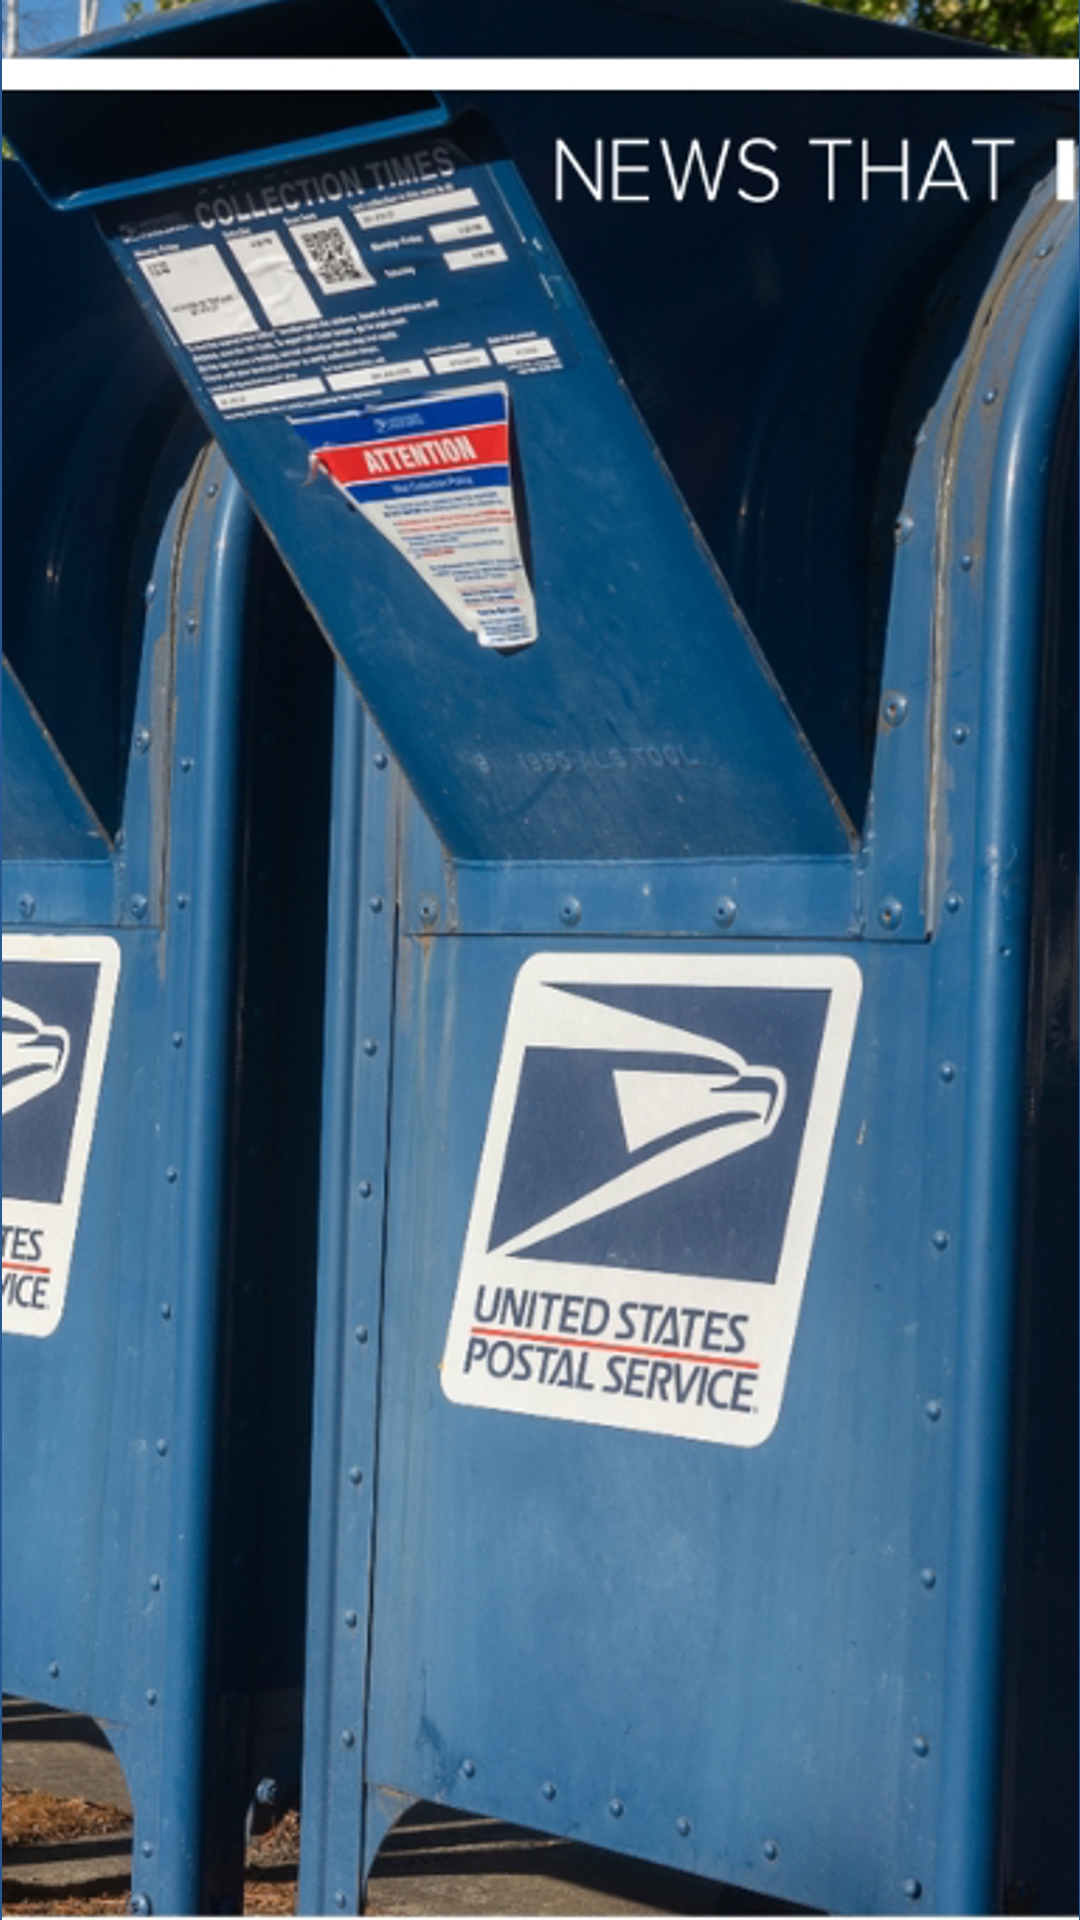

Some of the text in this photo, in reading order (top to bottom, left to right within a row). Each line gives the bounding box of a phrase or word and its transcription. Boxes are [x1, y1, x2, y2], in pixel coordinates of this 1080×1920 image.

[195, 166, 366, 229] COLLECTION
[365, 146, 456, 191] TIMES
[362, 435, 477, 474] ATTENTION
[473, 1284, 750, 1354] UNITED STATES
[462, 1336, 759, 1414] POSTAL SERVICE
